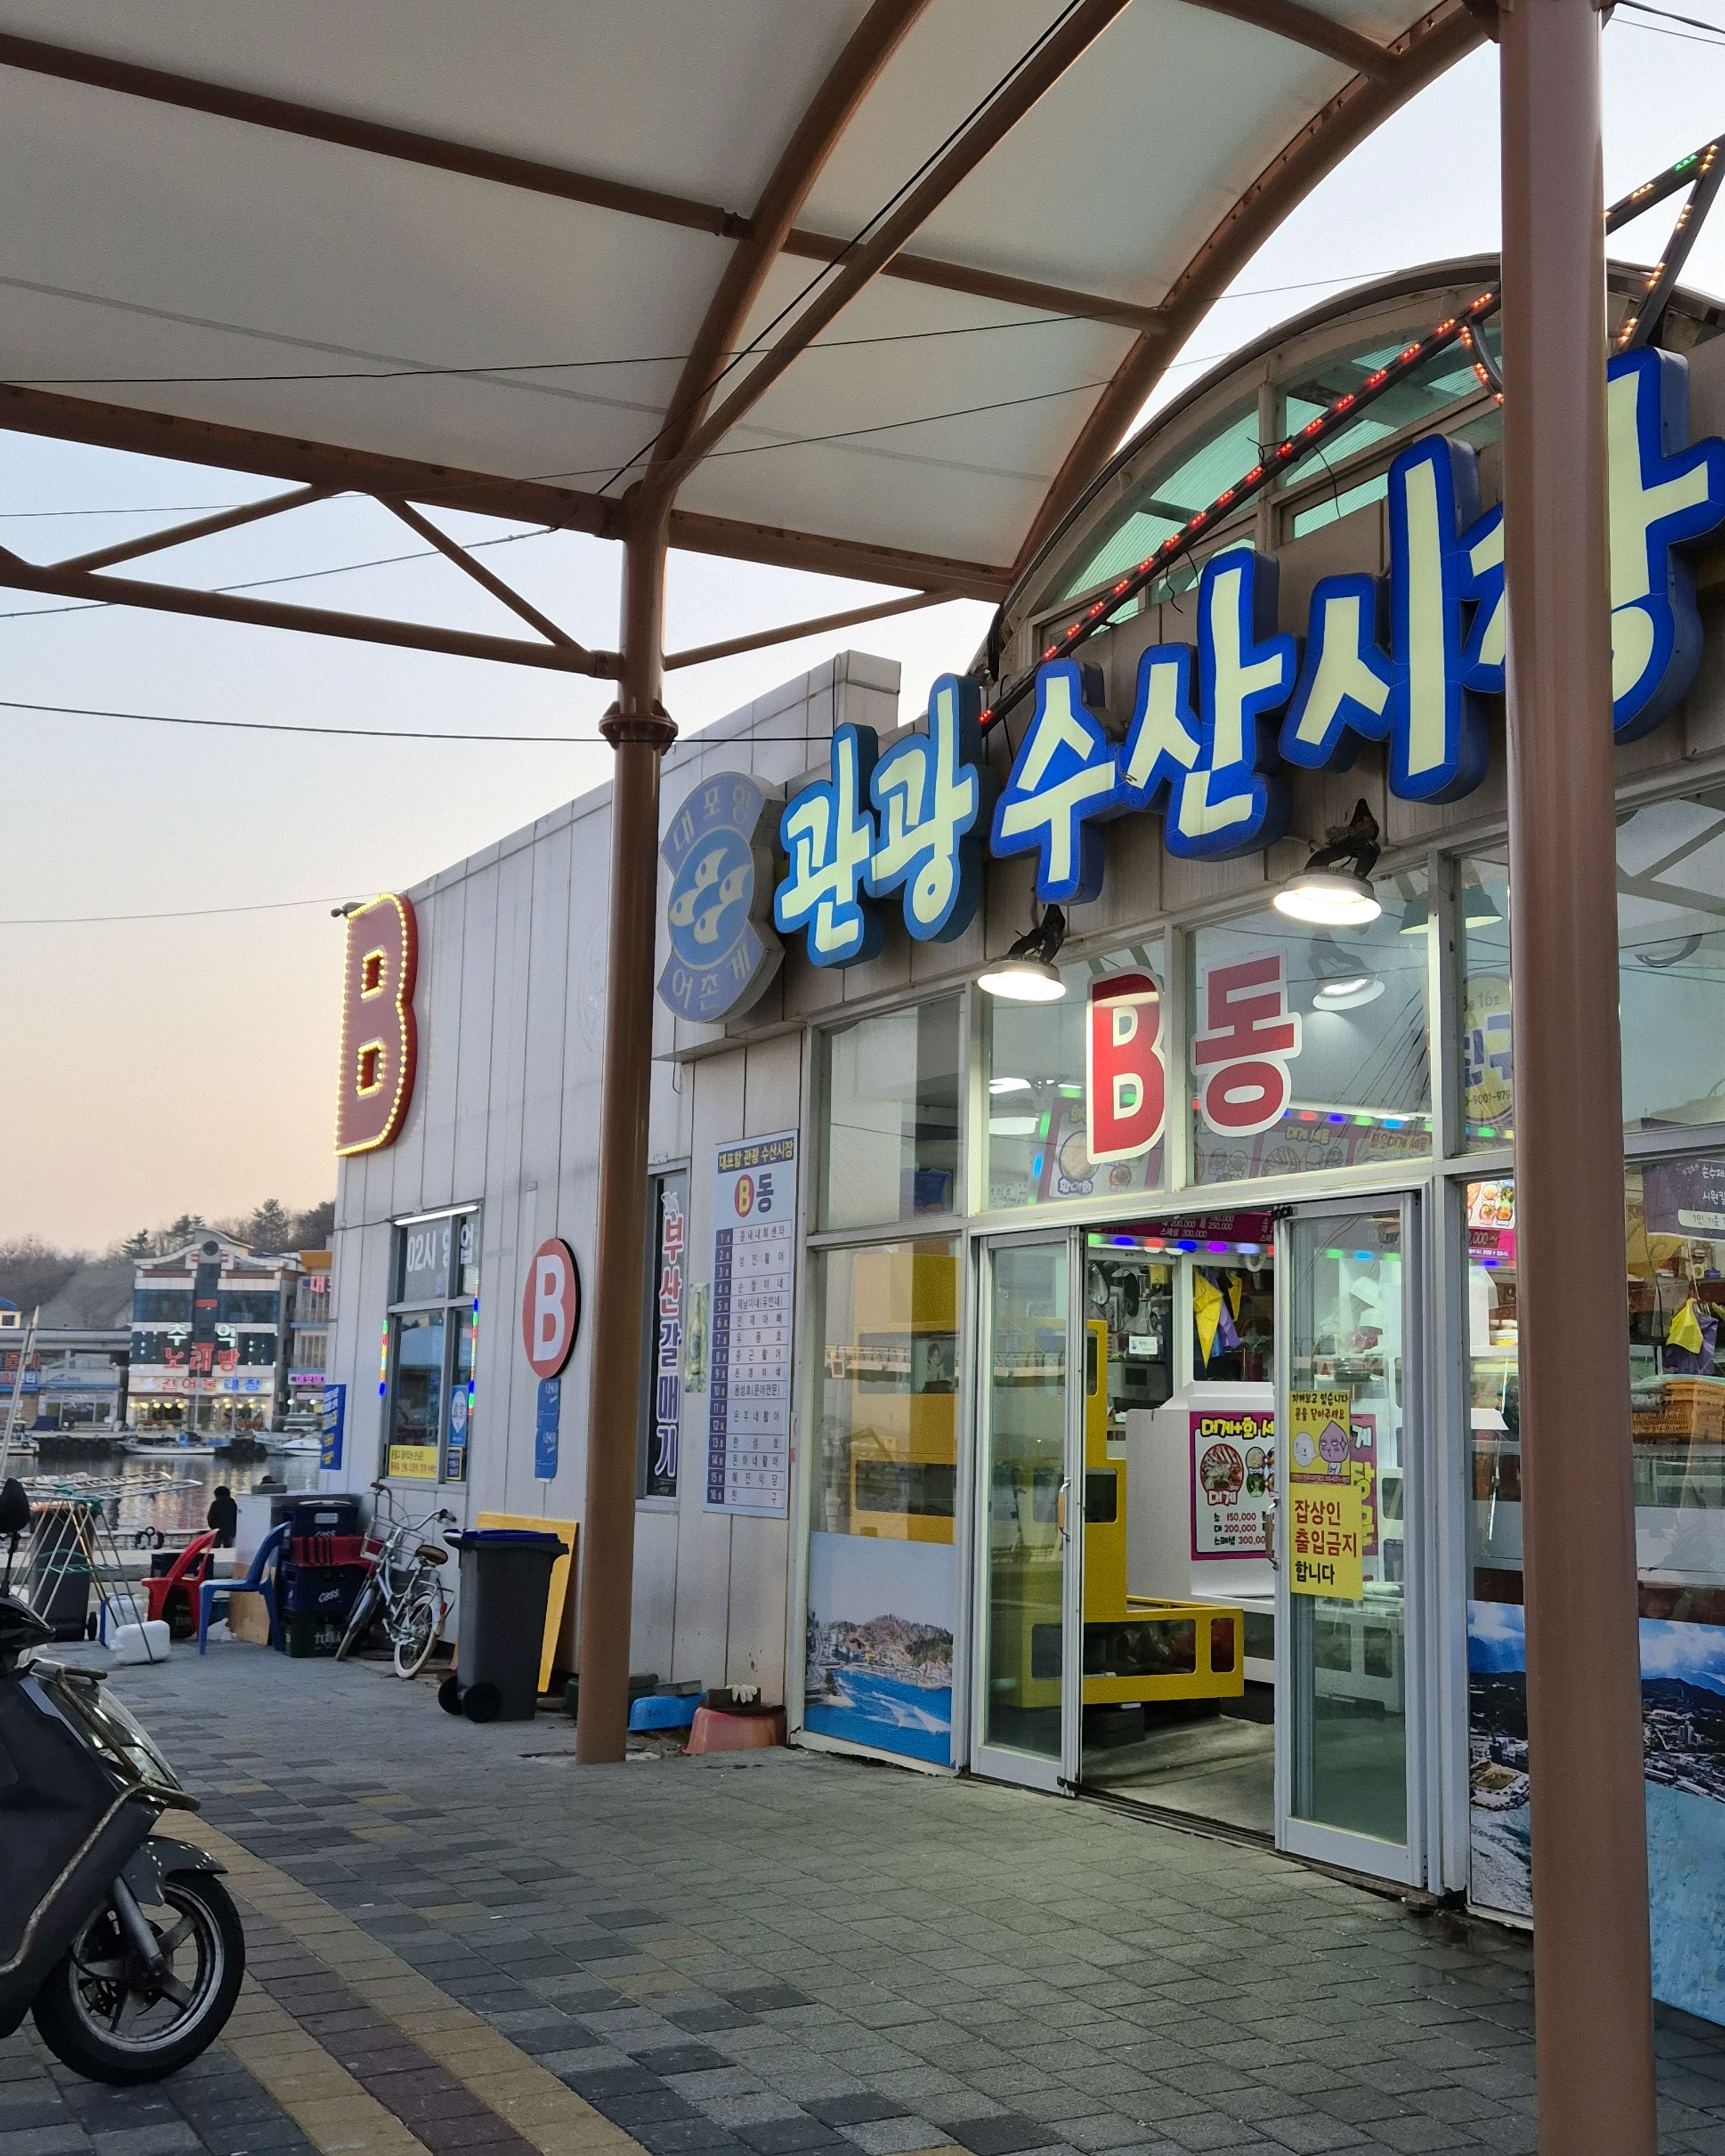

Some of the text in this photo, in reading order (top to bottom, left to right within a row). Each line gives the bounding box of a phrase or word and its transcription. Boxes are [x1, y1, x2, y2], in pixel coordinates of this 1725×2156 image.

[672, 781, 752, 854] 대포항
[775, 673, 979, 969] 관광
[671, 947, 752, 1012] 어촌계
[332, 892, 417, 1158] B
[744, 1146, 759, 1166] 관광
[761, 1140, 793, 1163] 수산시장
[533, 1254, 565, 1361] B
[166, 1322, 236, 1348] 추억
[654, 1213, 685, 1478] 부산갈매기
[163, 1346, 240, 1372] 노래방
[1226, 1512, 1256, 1522] 150,000
[1294, 1499, 1340, 1526] 잡상인
[1224, 1524, 1257, 1533] 200,000
[1238, 1536, 1266, 1545] 300,00
[1295, 1527, 1357, 1558] 출입금지
[1295, 1560, 1335, 1586] 합니다
